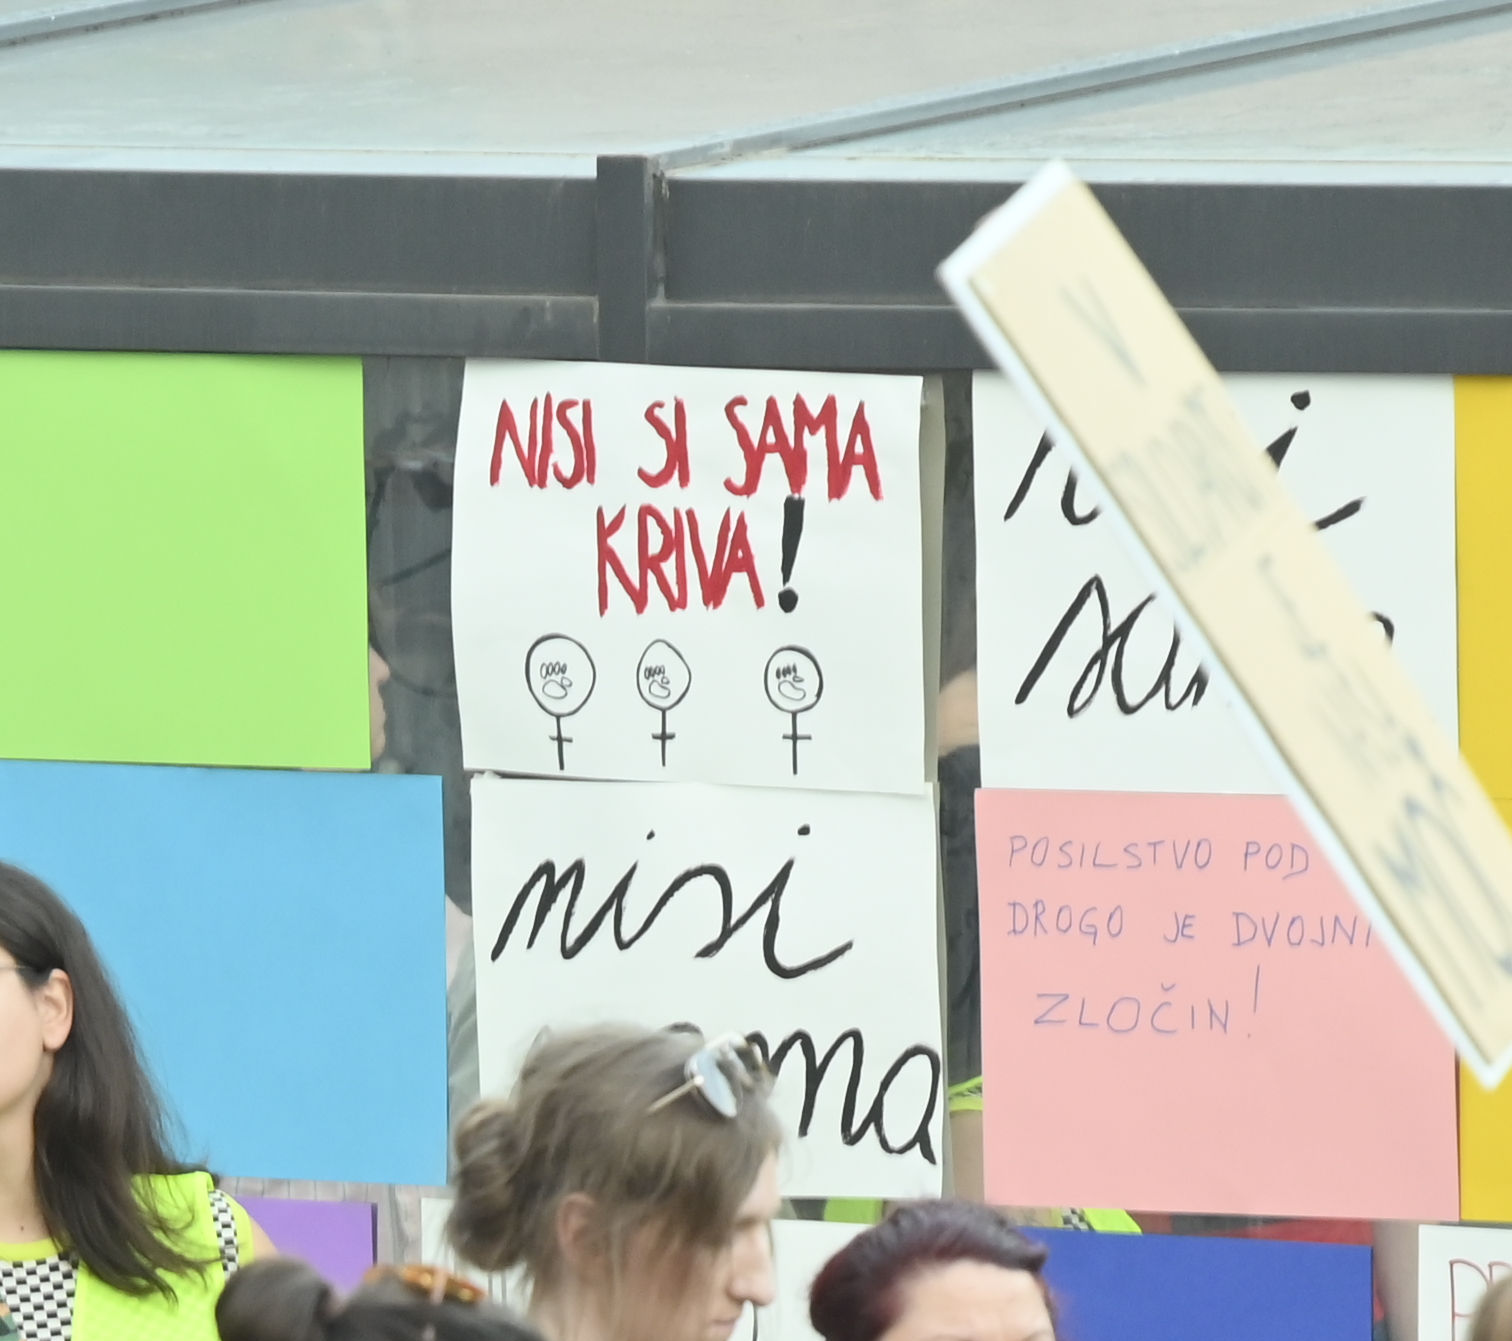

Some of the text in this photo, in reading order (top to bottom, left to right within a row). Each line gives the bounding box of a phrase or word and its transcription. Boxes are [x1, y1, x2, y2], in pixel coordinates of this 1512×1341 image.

[489, 391, 883, 502] NISI SI SAMA
[596, 493, 805, 617] KRIVA!
[490, 823, 854, 980] nisi
[1008, 835, 1310, 880] POSILSTVO POD
[1007, 899, 1125, 945] DROGO
[1163, 912, 1198, 943] JE
[1033, 964, 1261, 1039] ZLOČIN!
